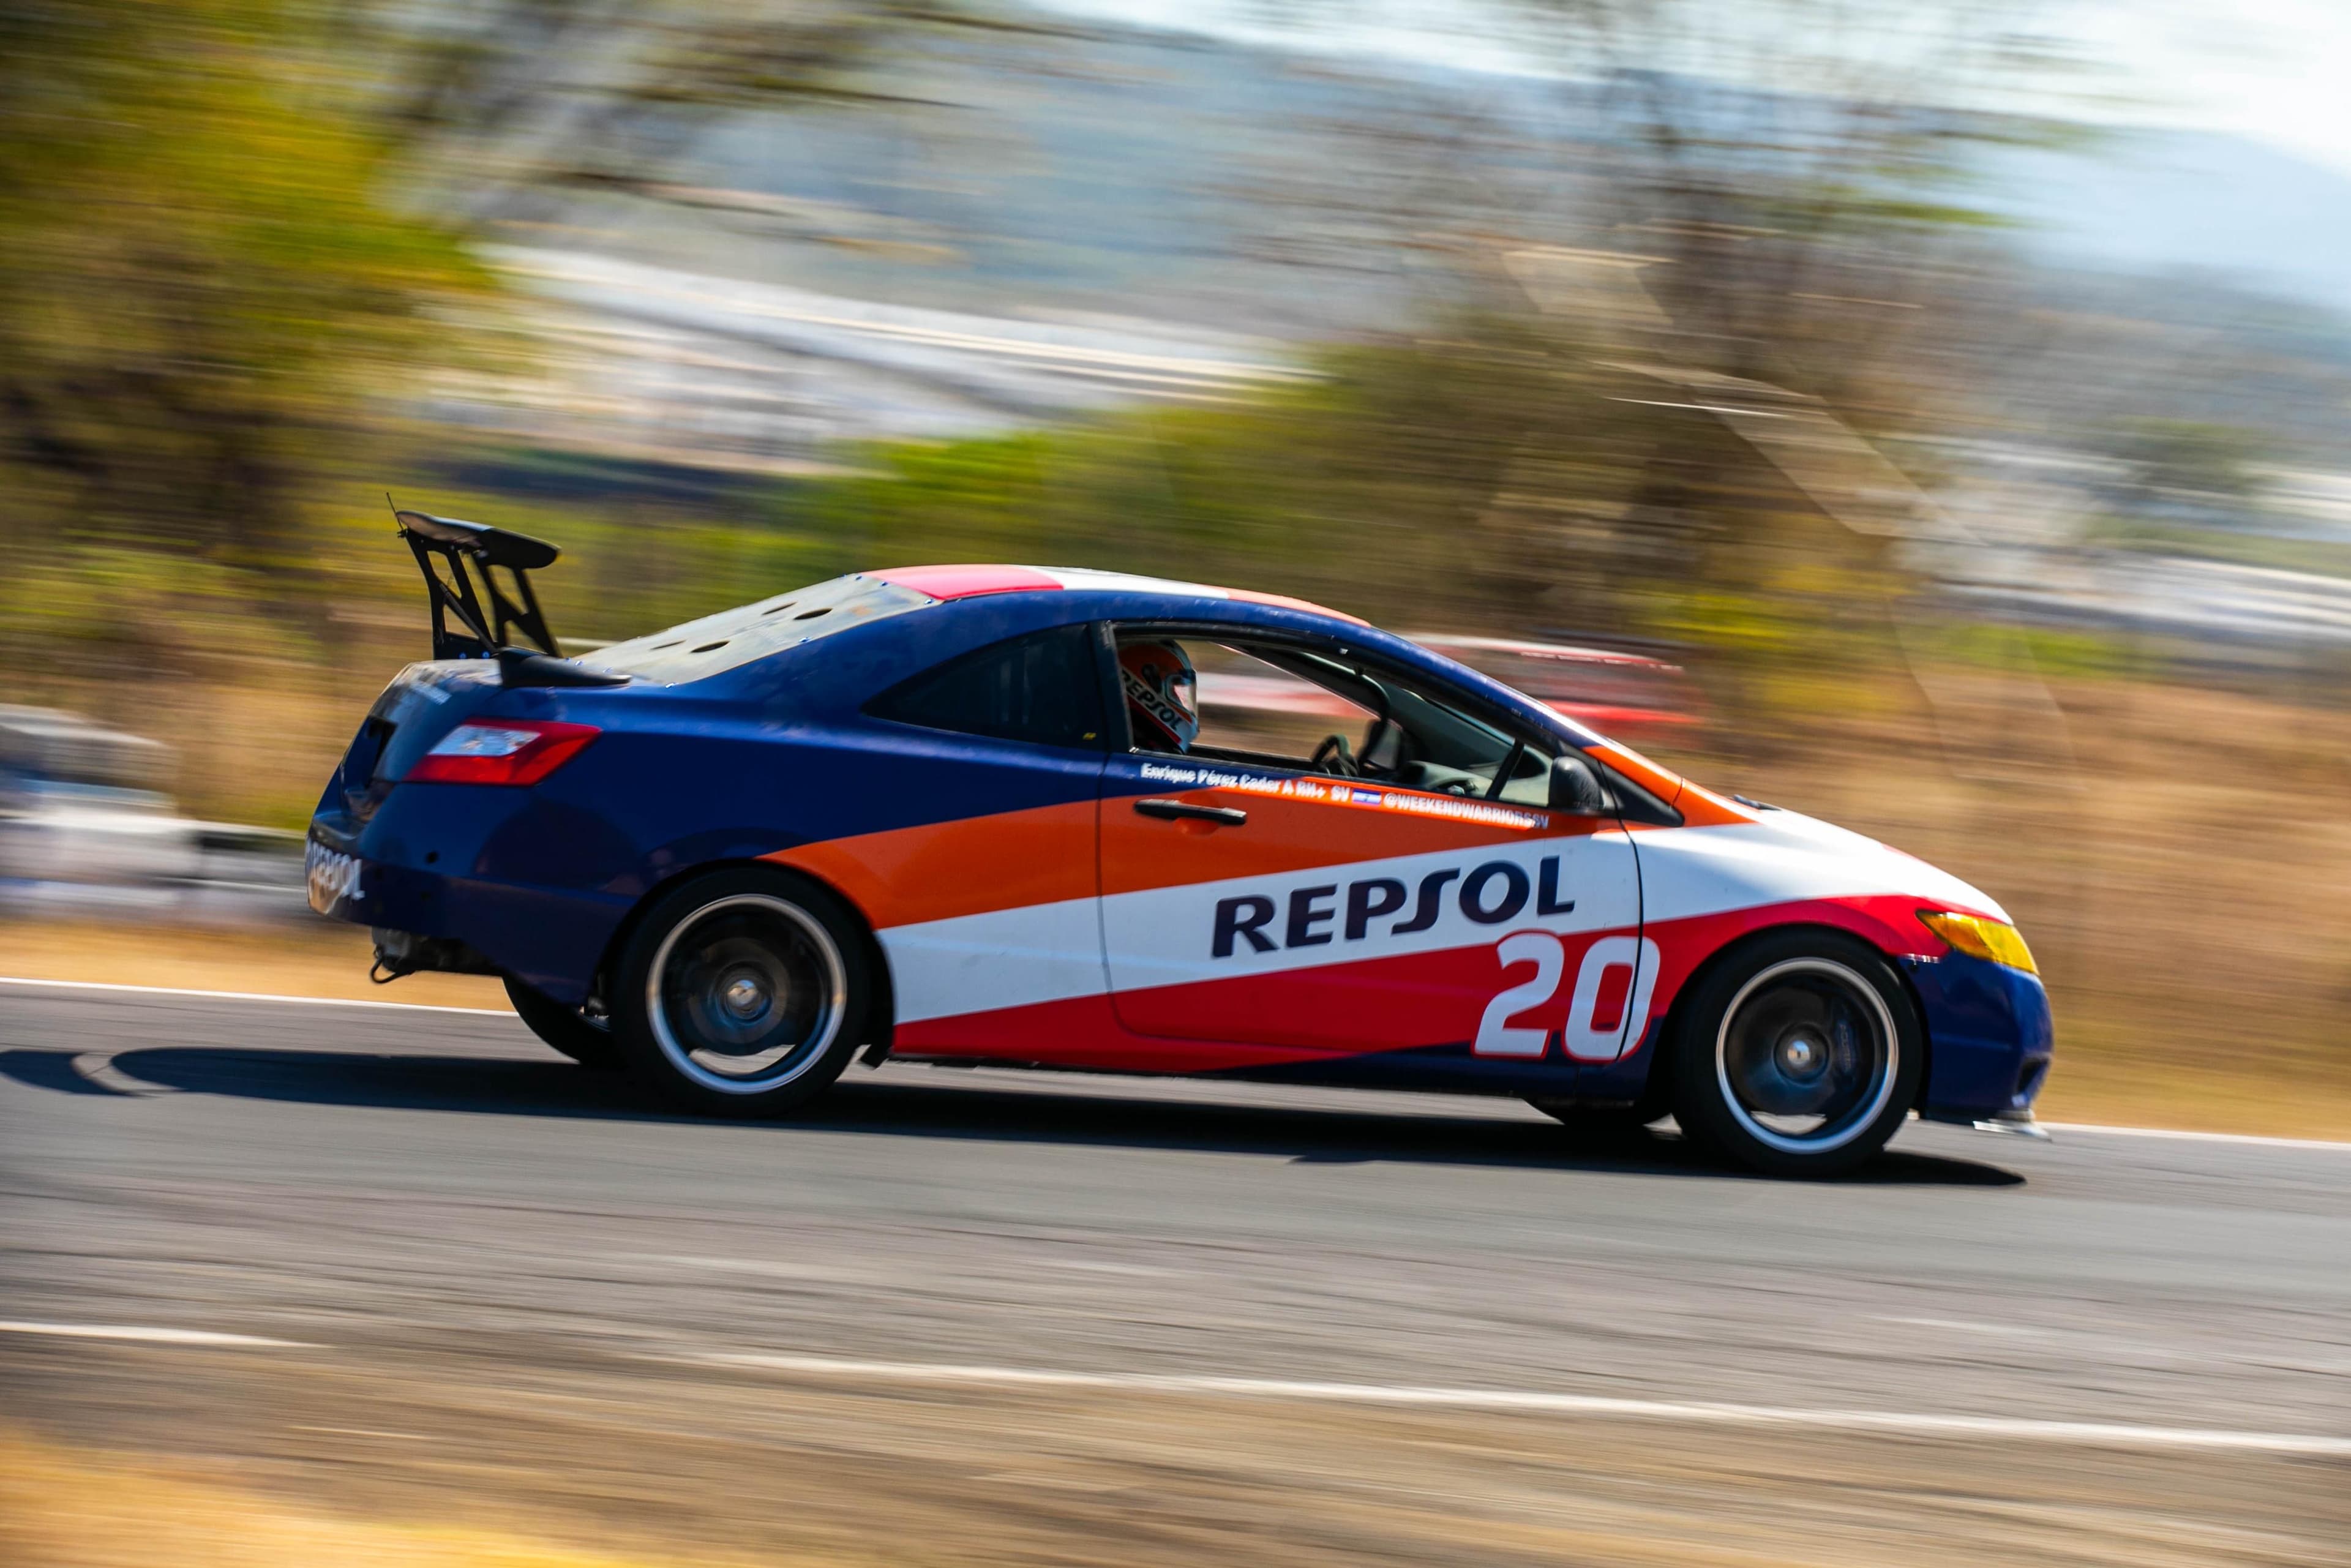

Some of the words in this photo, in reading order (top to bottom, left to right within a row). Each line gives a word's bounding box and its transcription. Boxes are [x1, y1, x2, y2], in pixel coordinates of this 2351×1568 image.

[1141, 763, 1196, 784] Enrique
[1197, 769, 1238, 788] Pérez
[1282, 779, 1294, 795] A
[1331, 786, 1351, 802] SV
[1210, 855, 1575, 959] REPSOL
[1473, 929, 1661, 1063] 20
